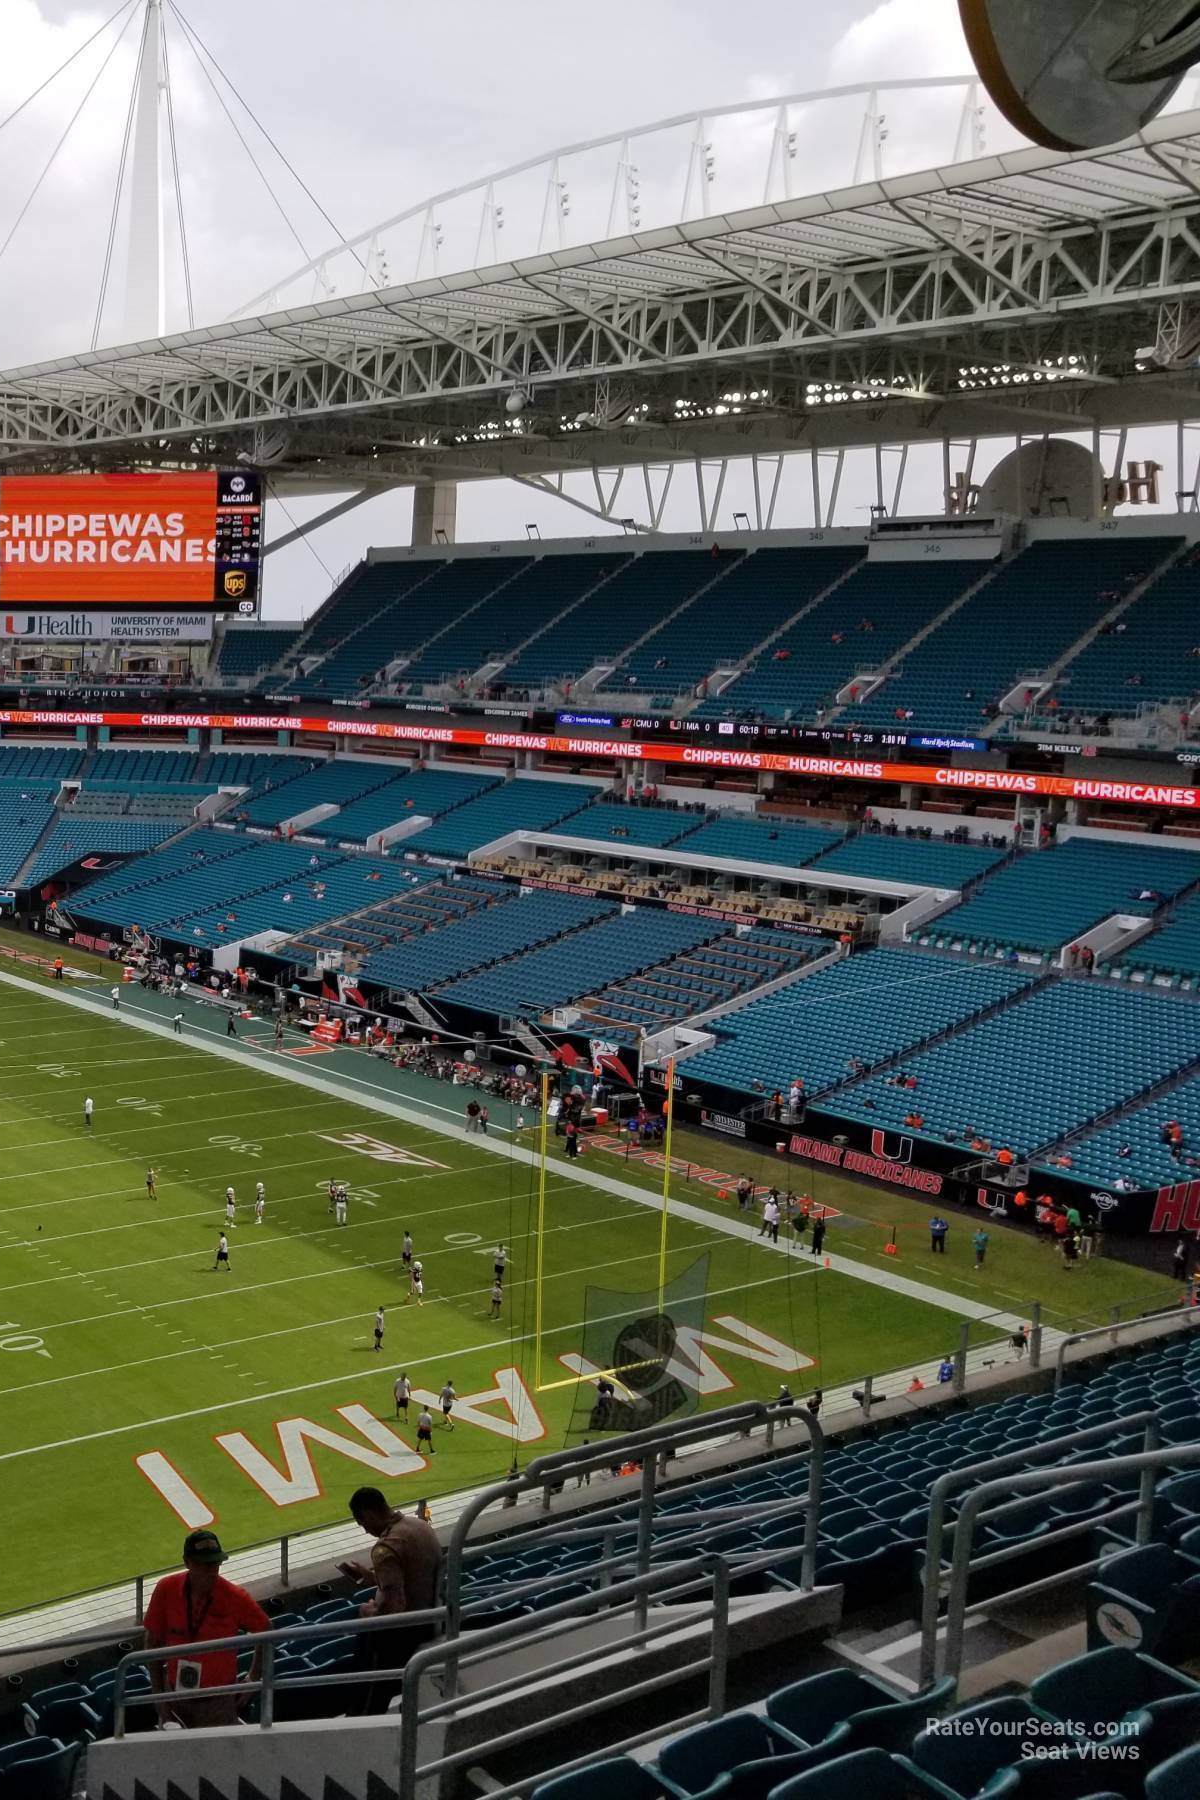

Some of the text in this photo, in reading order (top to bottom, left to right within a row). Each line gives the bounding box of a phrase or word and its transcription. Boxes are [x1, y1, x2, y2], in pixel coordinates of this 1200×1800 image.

[0, 513, 185, 537] CHIPPEWAS
[5, 540, 216, 563] HURRICANES
[226, 579, 244, 594] ups
[111, 616, 206, 626] UNIVERSITY OF MIAMI
[110, 626, 180, 637] HEALTH SYSTEM
[33, 713, 104, 723] HURRICANES
[141, 715, 302, 728] CHIPPEWAS HURRICANES
[636, 719, 652, 728] CMU
[327, 721, 377, 735] CHIPPEWAS
[394, 726, 453, 741] HURRICANES
[687, 722, 699, 731] MIA
[739, 724, 759, 734] 60:18
[484, 733, 547, 749] CHIPPEWAS
[568, 740, 642, 756] HURRICANES
[1037, 743, 1081, 754] JIM KELLY
[683, 748, 761, 767] CHIPPEWAS
[789, 757, 882, 777] HURRICANES
[935, 769, 1036, 791] CHIPPEWAS
[1073, 780, 1196, 804] HURRICANES
[714, 1114, 746, 1129] SYLVESTER
[316, 1132, 455, 1170] ACC
[789, 1135, 943, 1195] MIAMI HURRICANES
[133, 1315, 820, 1531] MIAMI
